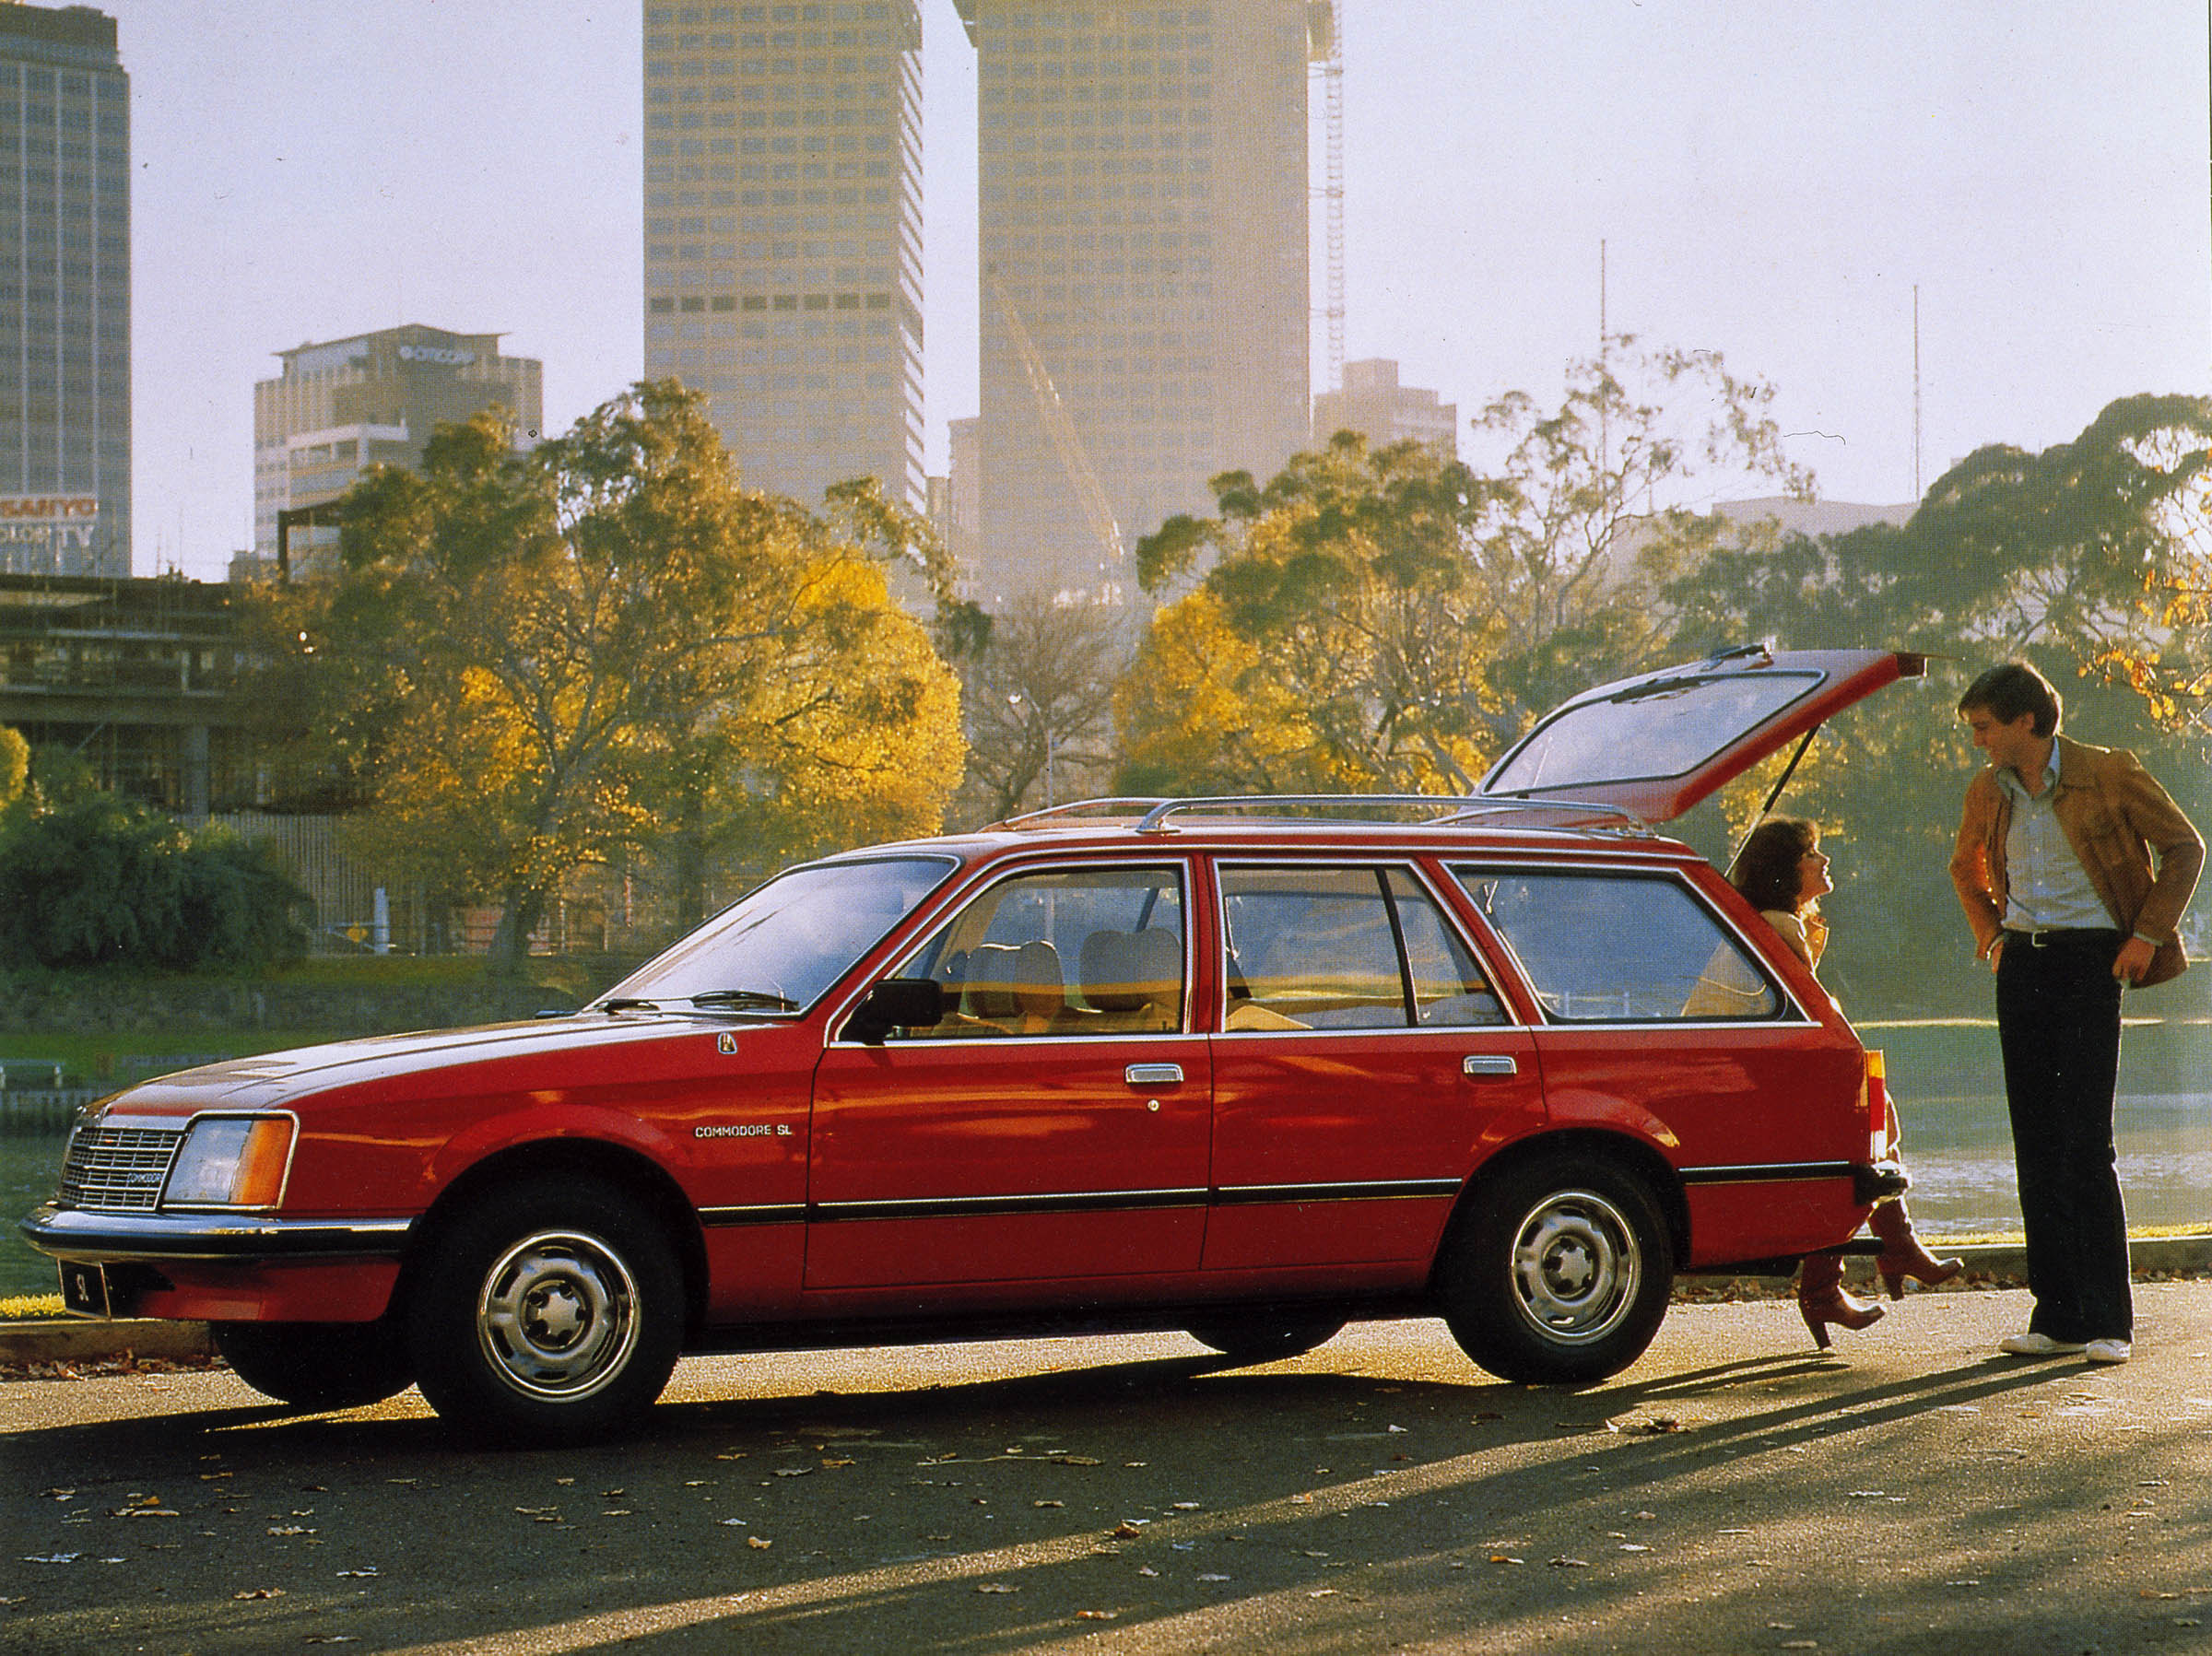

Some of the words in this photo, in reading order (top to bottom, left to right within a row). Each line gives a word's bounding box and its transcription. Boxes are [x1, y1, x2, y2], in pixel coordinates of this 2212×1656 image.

[57, 524, 95, 546] TV
[694, 1124, 771, 1138] COMMODORE
[776, 1123, 793, 1135] SL
